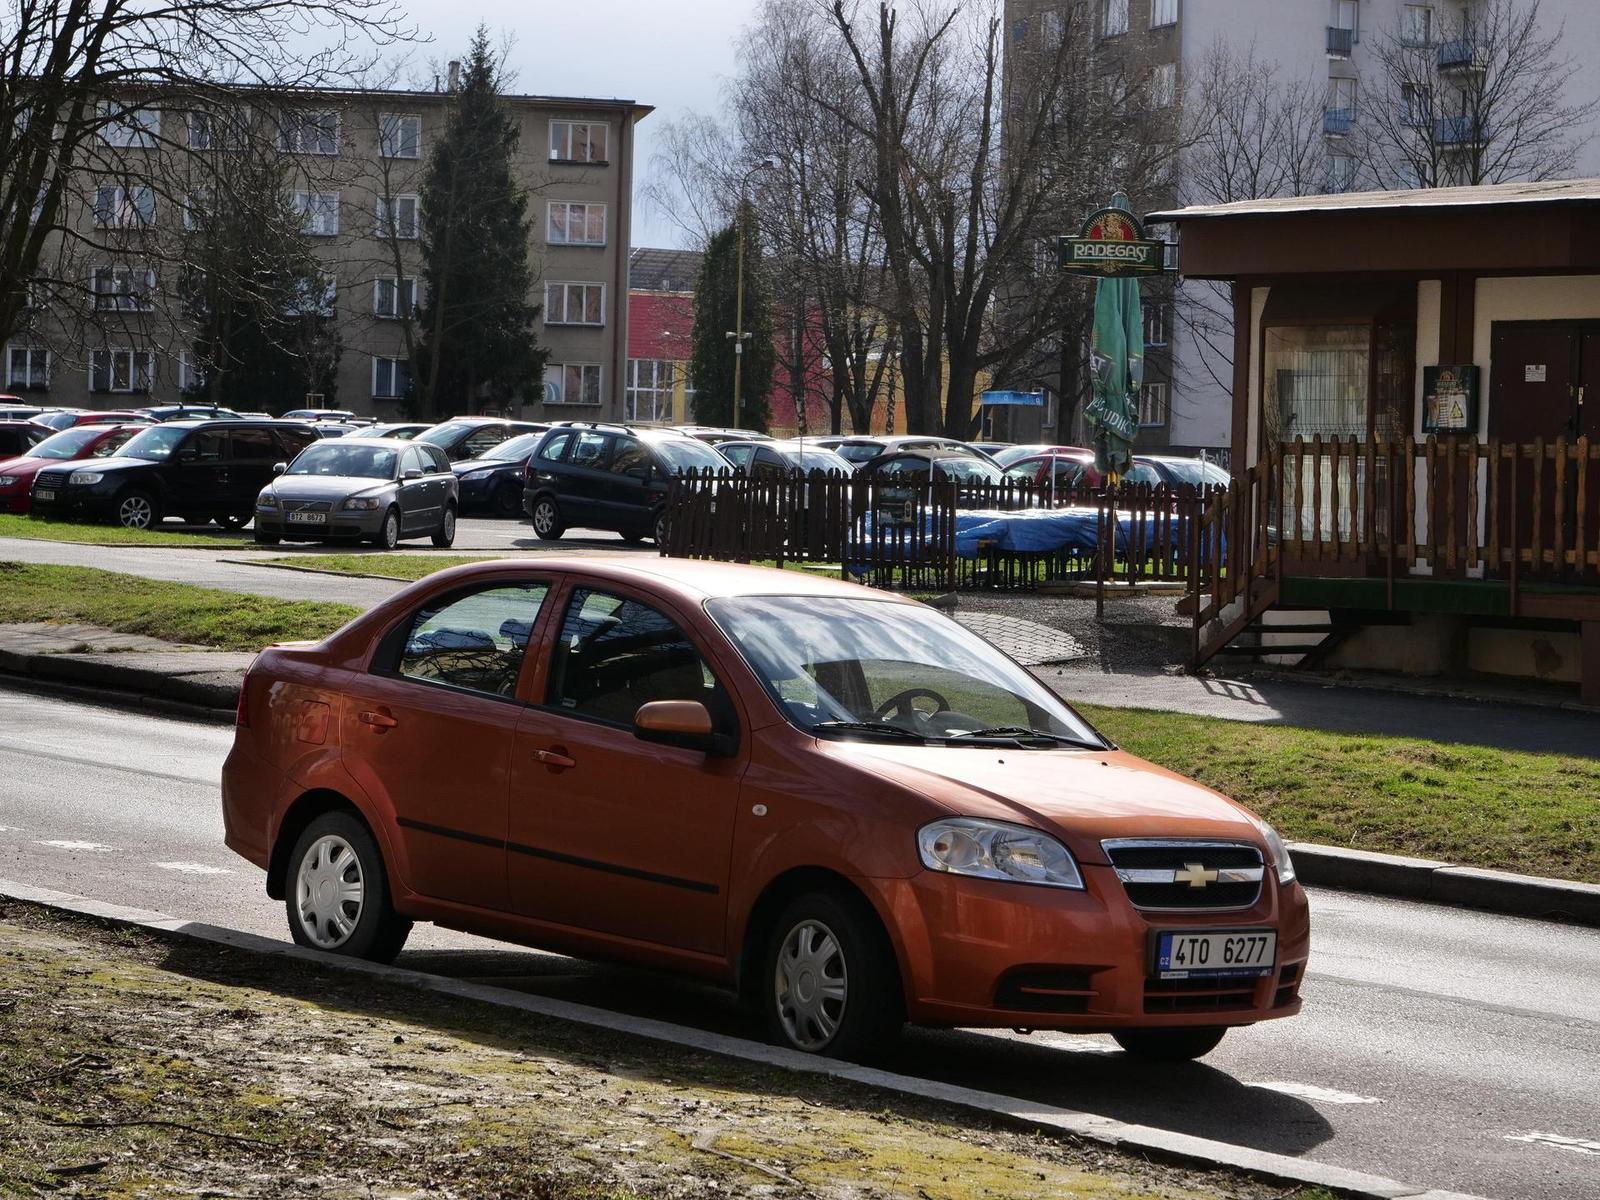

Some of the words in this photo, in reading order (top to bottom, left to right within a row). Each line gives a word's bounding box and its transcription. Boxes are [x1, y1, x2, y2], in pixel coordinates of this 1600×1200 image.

[1074, 244, 1150, 262] RADEGAST
[1175, 938, 1210, 965] 4T0
[1223, 937, 1267, 963] 6277
